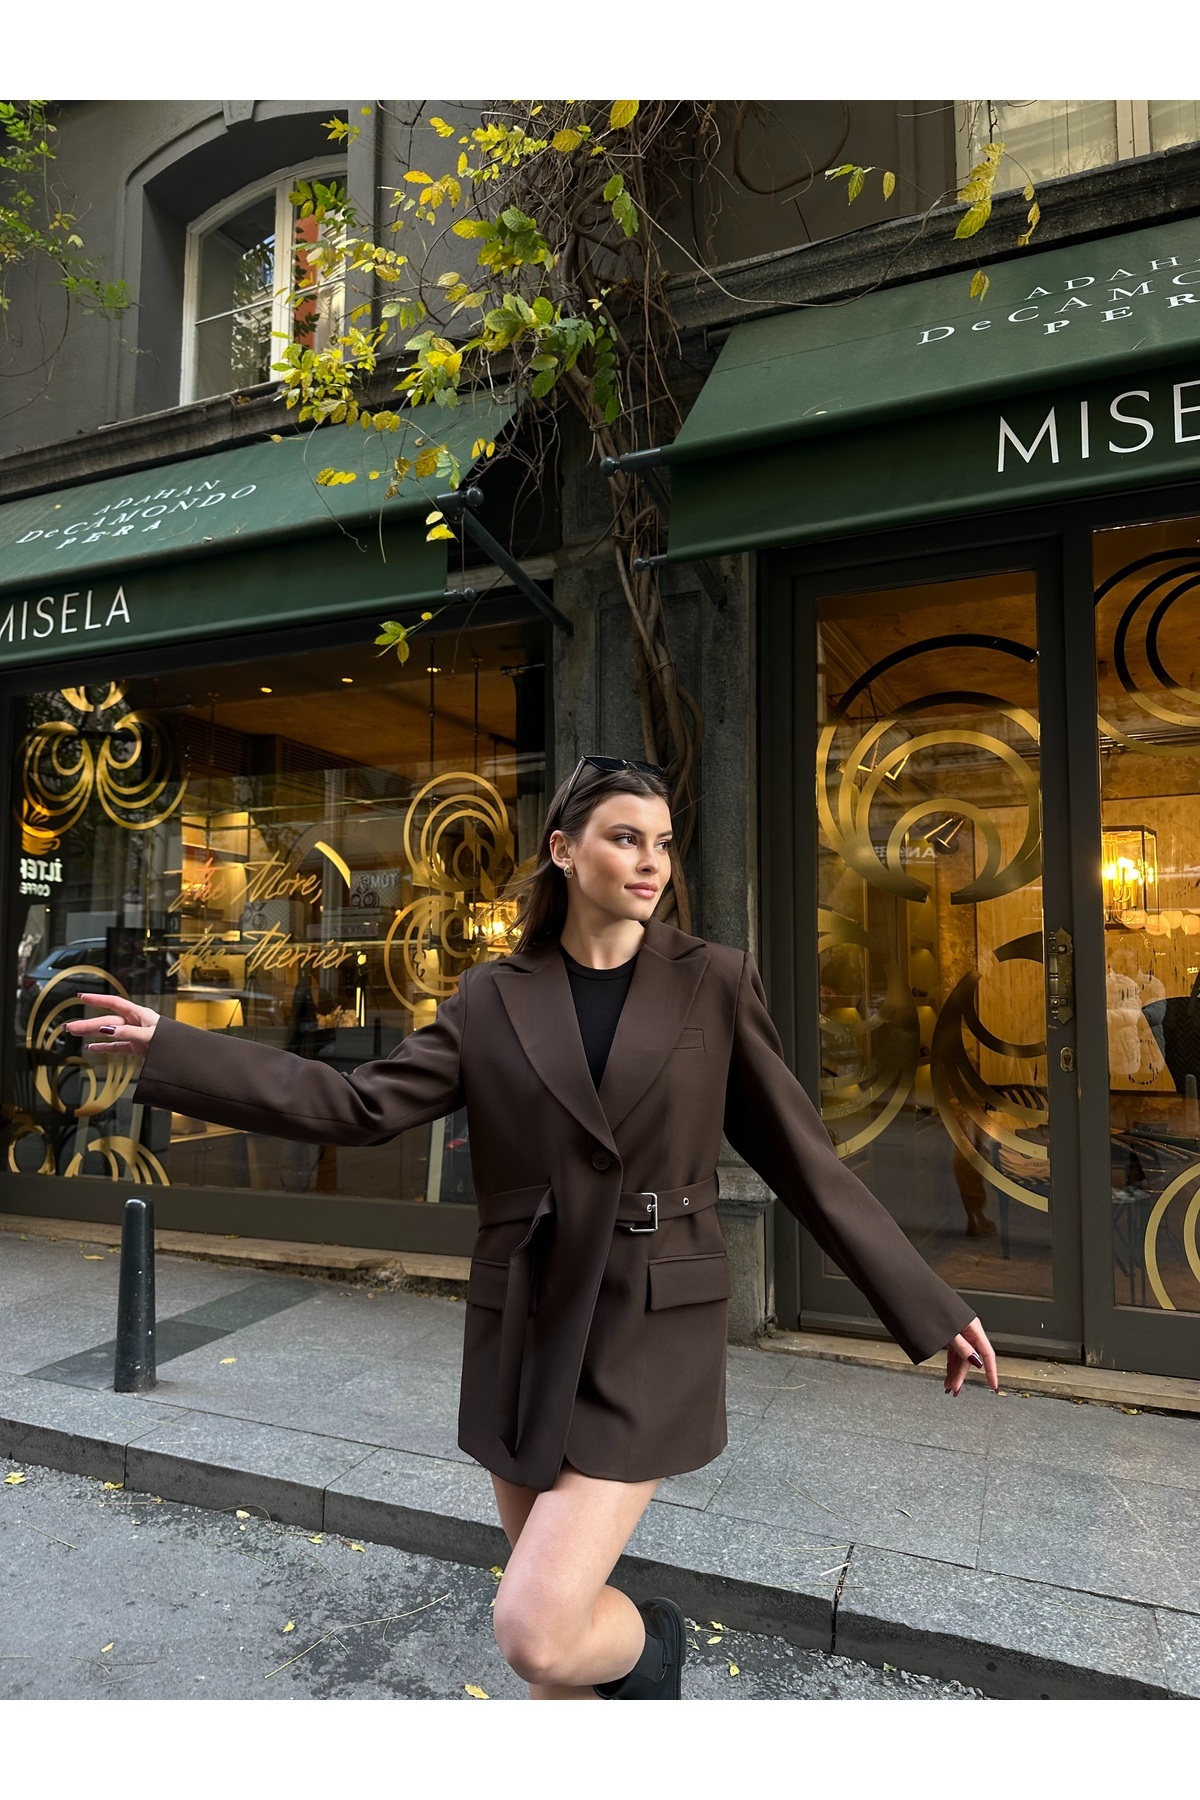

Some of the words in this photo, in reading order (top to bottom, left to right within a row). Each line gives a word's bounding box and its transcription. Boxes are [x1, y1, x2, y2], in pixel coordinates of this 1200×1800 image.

[1024, 255, 1200, 301] ADAH
[997, 379, 1200, 473] MISE
[16, 484, 257, 544] DeCAMONDO
[93, 479, 221, 516] ADAHAN
[56, 519, 162, 550] PERA
[231, 849, 323, 905] More,
[241, 920, 353, 971] Merrier
